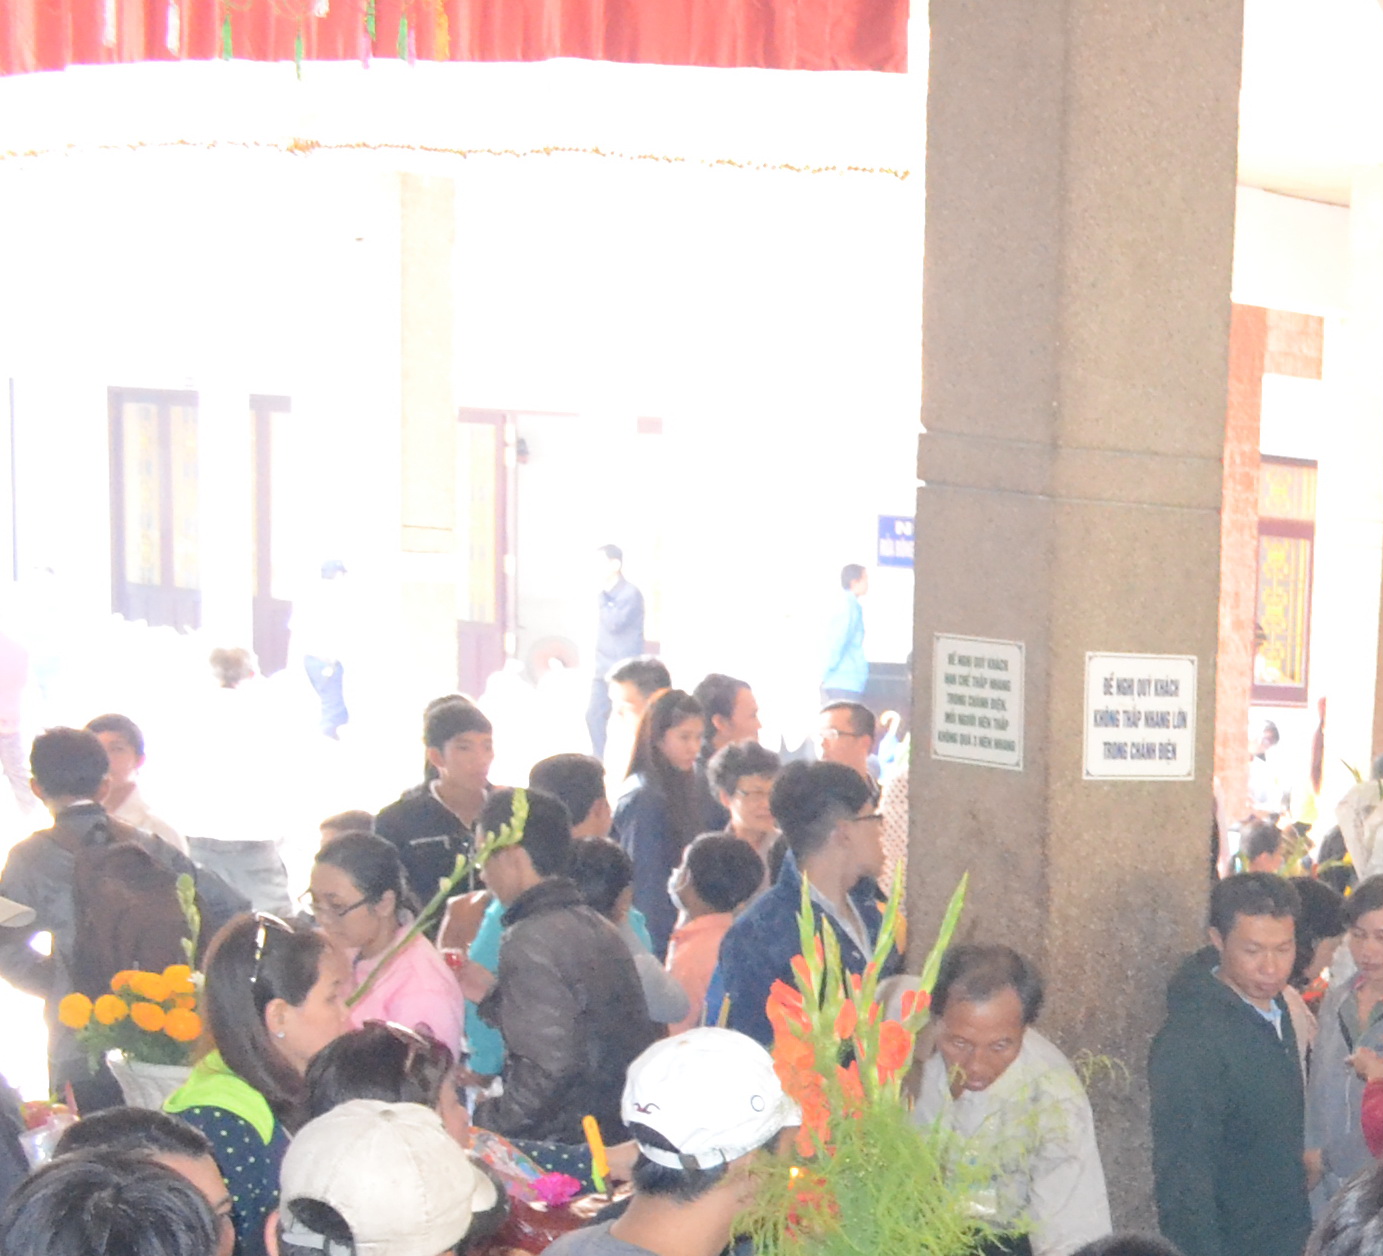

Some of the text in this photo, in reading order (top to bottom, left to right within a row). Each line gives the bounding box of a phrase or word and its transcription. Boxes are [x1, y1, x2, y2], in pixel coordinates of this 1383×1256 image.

[1154, 674, 1180, 697] KHÁCH
[1093, 706, 1120, 728] KHÔNG
[1144, 711, 1171, 730] NHANG
[1103, 741, 1128, 760] TRONG
